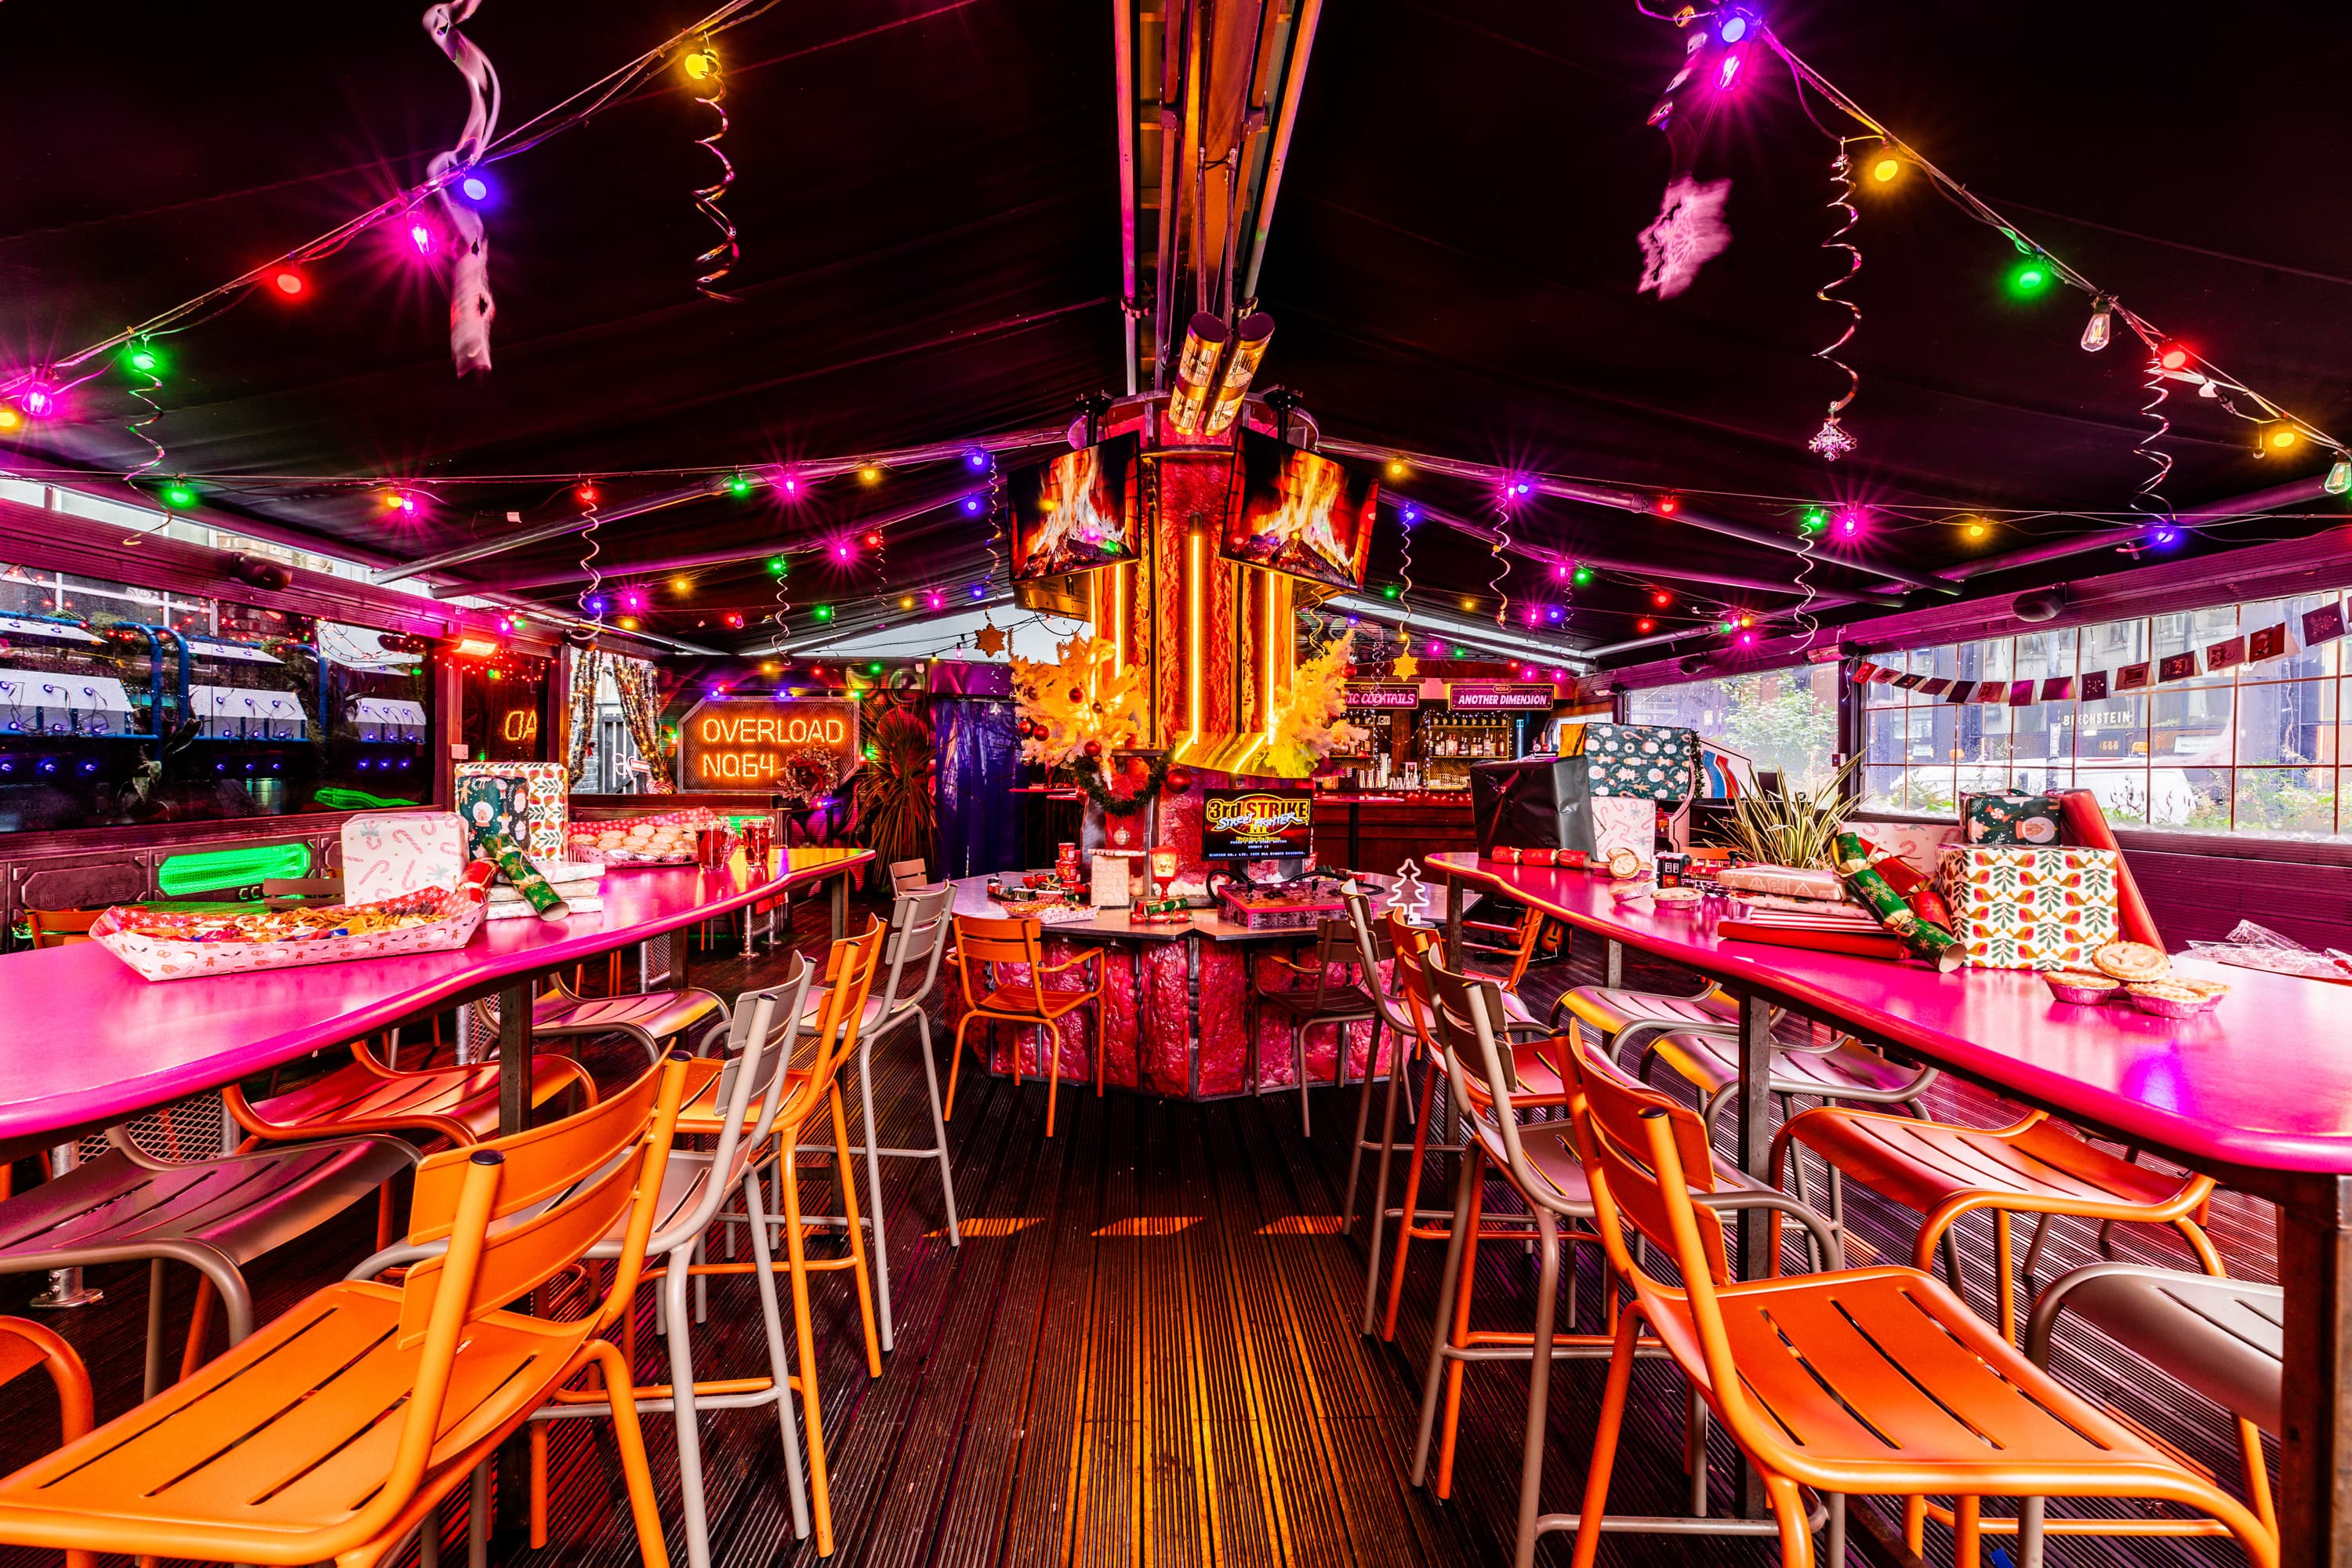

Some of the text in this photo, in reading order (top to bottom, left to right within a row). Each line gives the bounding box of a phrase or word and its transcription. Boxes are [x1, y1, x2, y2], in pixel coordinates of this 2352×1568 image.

[1361, 693, 1416, 705] COCKTAILS
[1458, 695, 1547, 705] ANOTHER DIMENSION
[702, 718, 844, 743] OVERLOAD
[702, 753, 774, 778] NQ64
[1209, 800, 1308, 819] 3rd STRIKE
[1216, 811, 1304, 831] STREET FIGHTER
